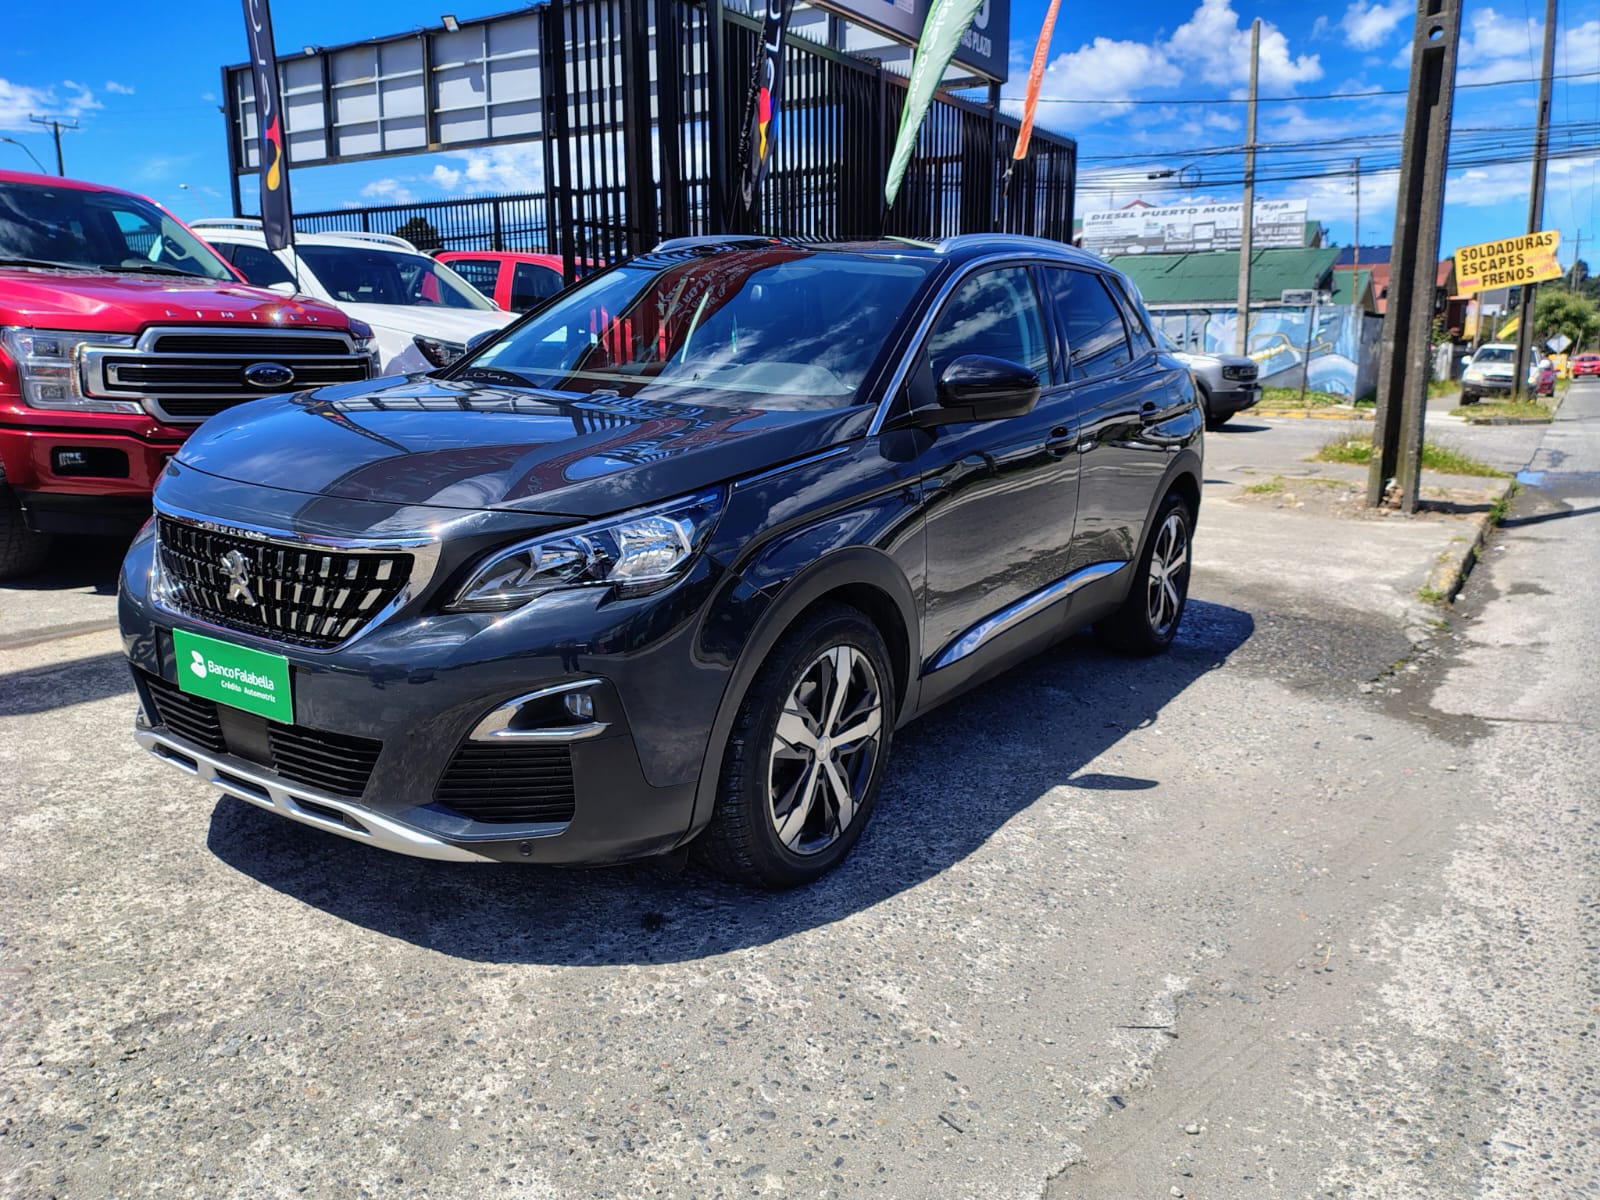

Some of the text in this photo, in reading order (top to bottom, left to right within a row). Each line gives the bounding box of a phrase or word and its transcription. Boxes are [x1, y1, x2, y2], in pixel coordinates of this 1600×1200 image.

[1091, 211, 1137, 221] DIESEL
[1141, 207, 1197, 218] PUERTO
[1461, 233, 1553, 262] SOLDADURAS
[1462, 253, 1525, 276] ESCAPES
[1482, 266, 1535, 287] FRENOS
[244, 687, 276, 703] Automotriz
